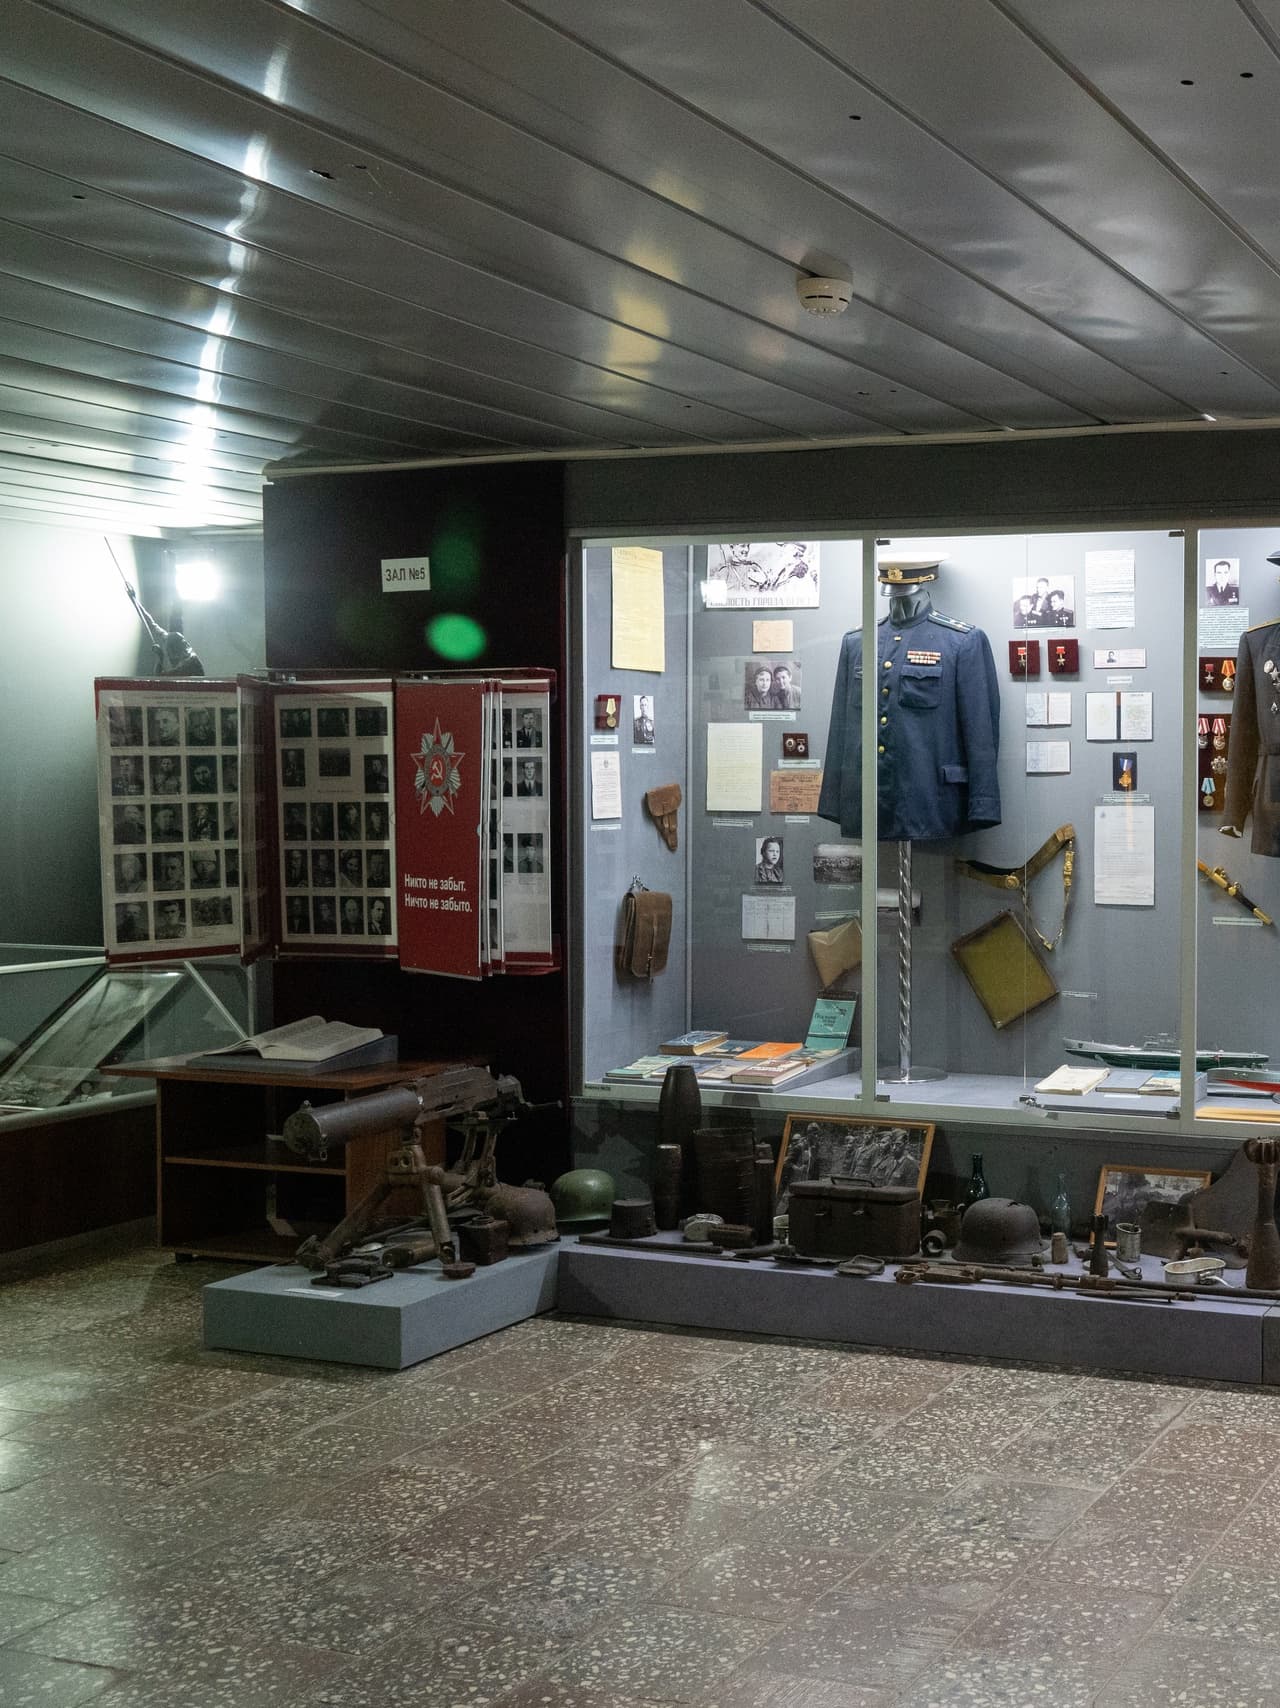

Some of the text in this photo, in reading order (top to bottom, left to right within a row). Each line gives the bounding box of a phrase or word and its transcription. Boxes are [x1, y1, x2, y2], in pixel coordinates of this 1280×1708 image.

[385, 567, 426, 582] ЗАЛ №5
[404, 873, 466, 892] Никто не забыт.
[404, 893, 473, 913] Ничто не забыто.
